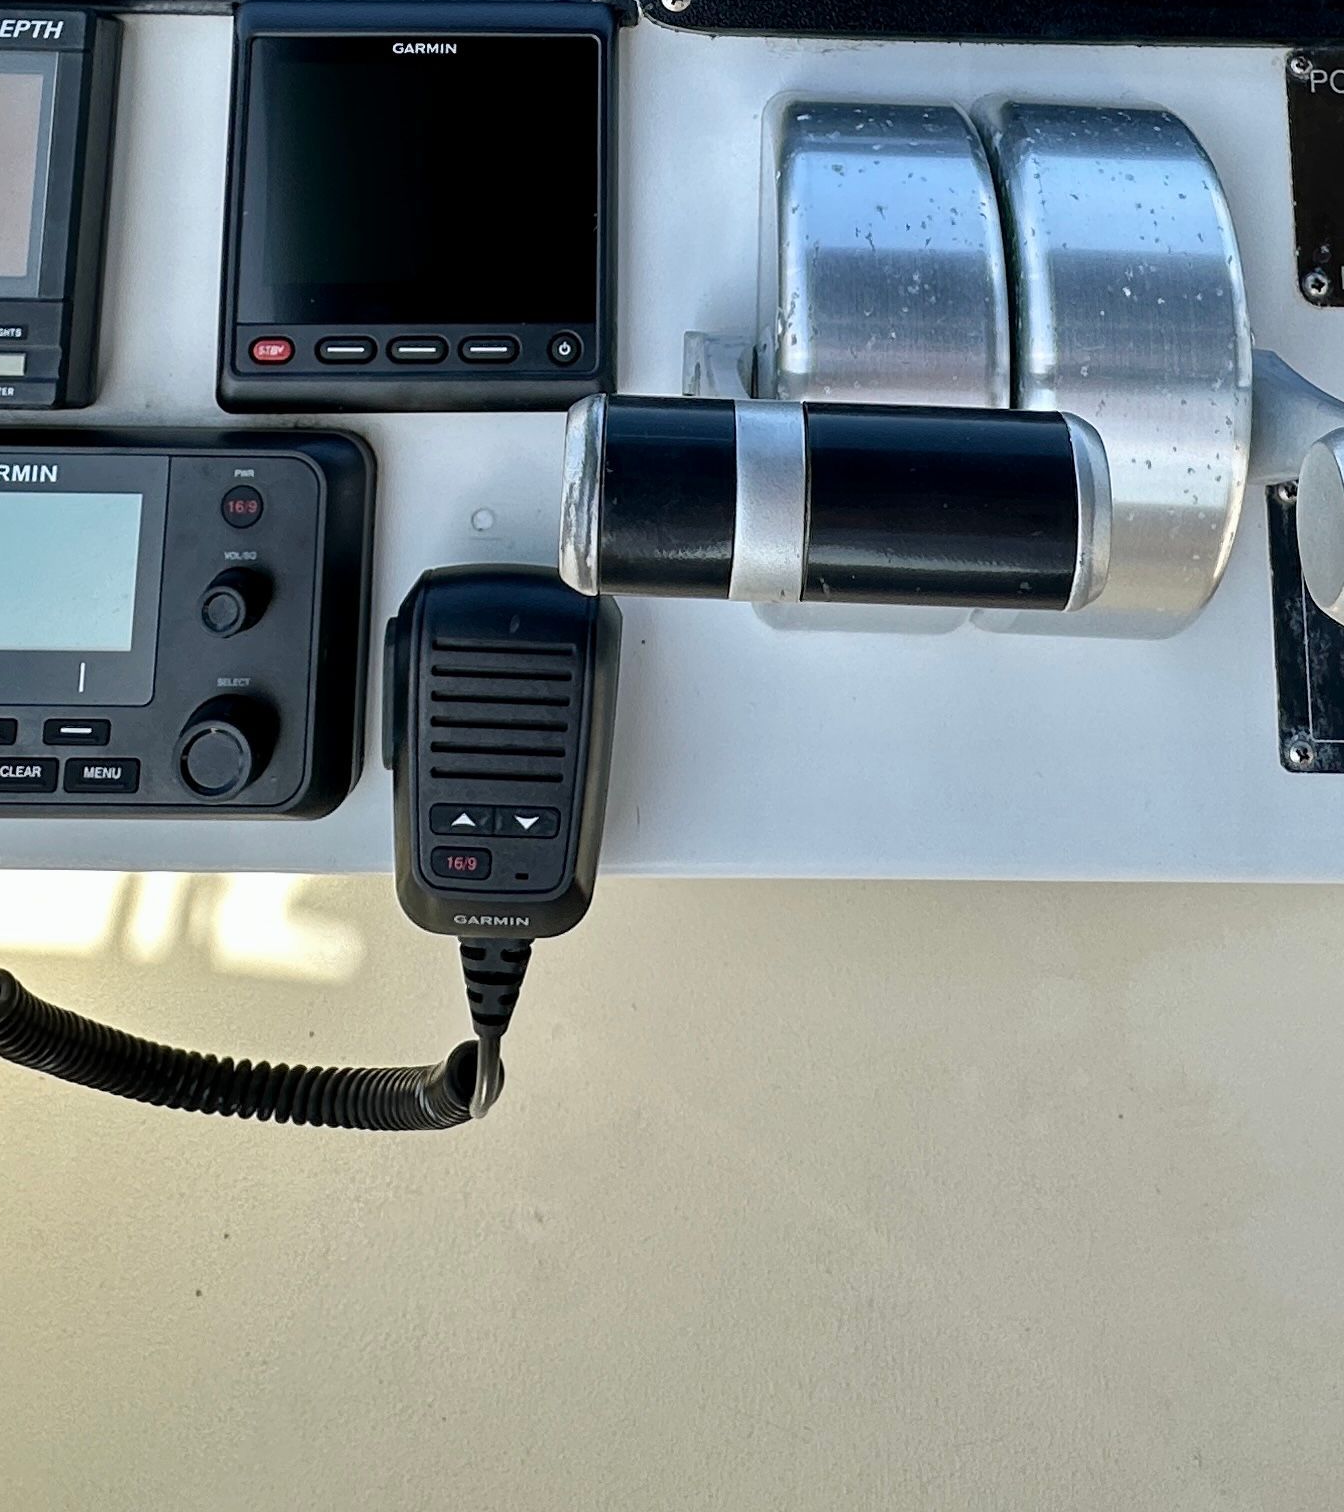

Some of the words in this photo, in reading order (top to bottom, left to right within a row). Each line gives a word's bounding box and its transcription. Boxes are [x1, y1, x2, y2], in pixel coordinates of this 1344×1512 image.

[392, 42, 457, 54] GARMIN
[229, 500, 258, 513] 16/9
[217, 678, 251, 687] SELECT
[0, 766, 42, 779] CLEAR
[83, 766, 121, 780] MENU
[447, 856, 478, 871] 16/9
[453, 915, 530, 926] GARMIN
